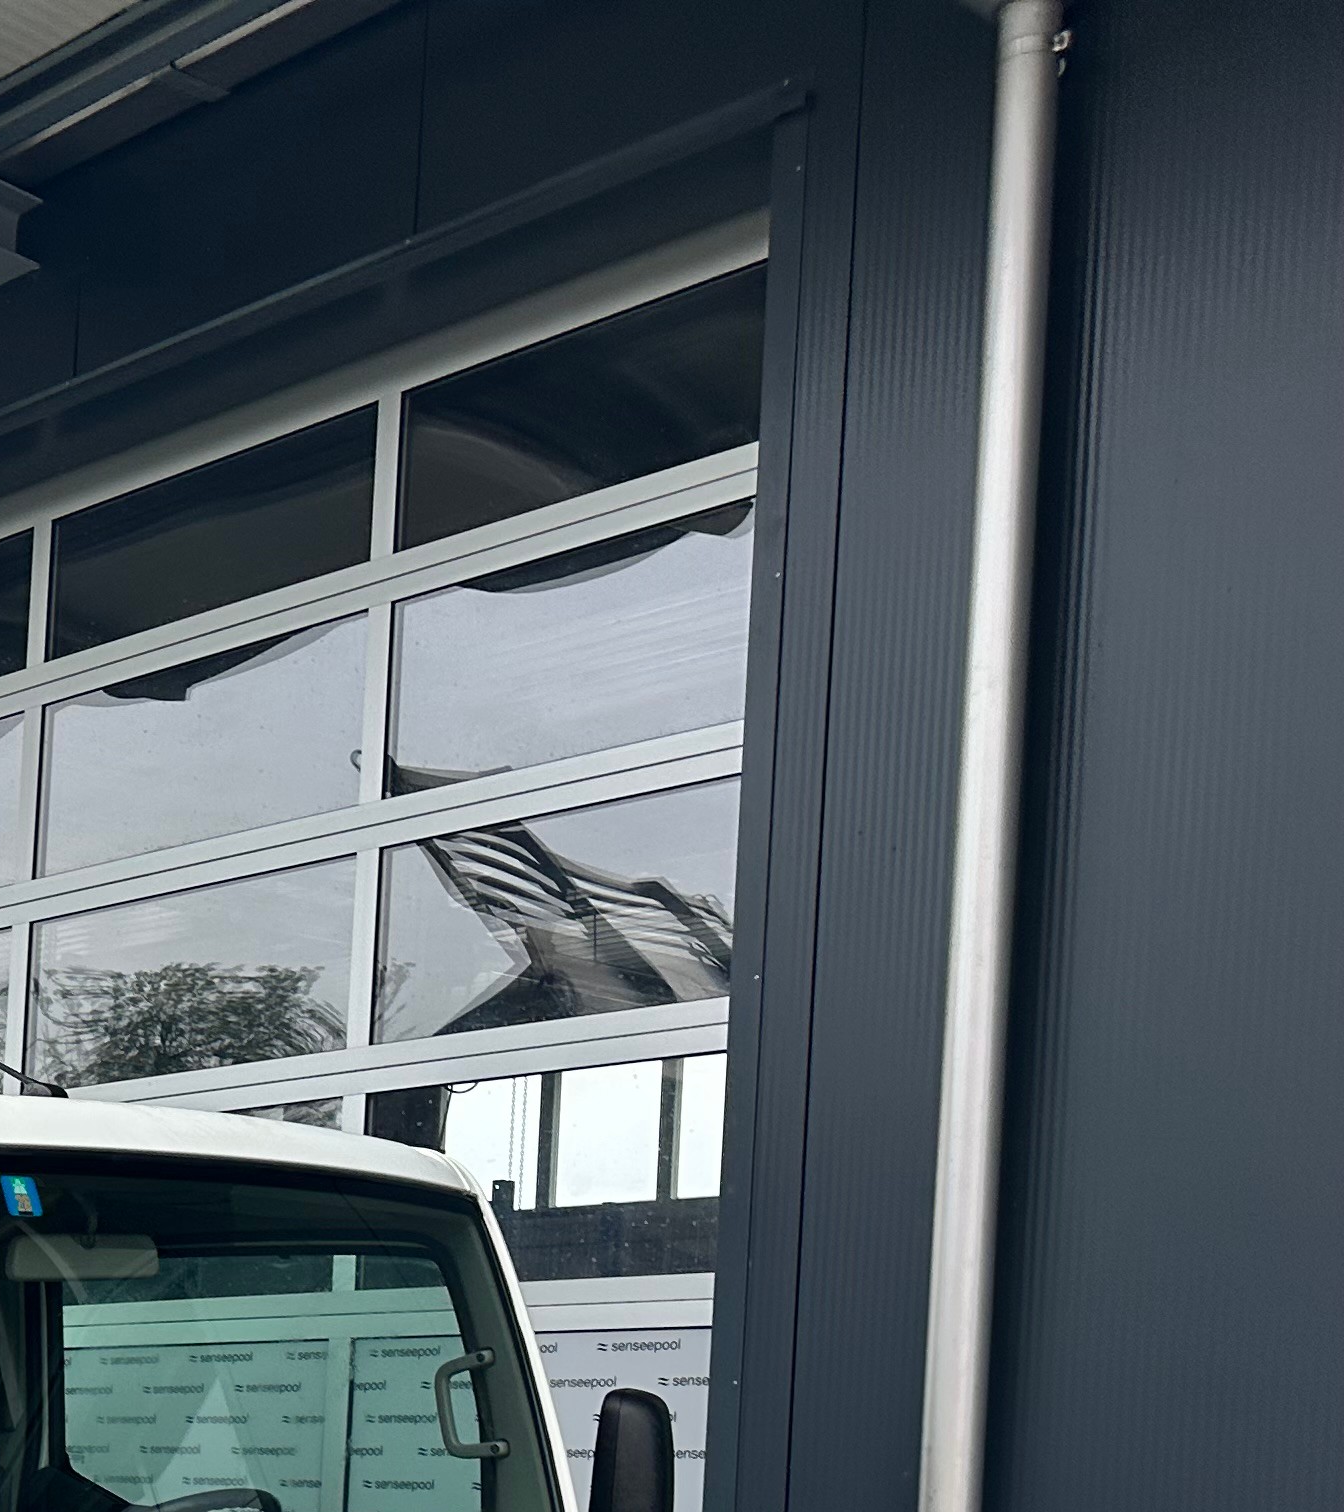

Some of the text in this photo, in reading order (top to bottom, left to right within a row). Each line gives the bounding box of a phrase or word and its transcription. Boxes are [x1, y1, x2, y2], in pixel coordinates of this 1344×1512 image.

[380, 1345, 441, 1361] senseepool
[611, 1338, 682, 1353] senseepool
[549, 1375, 618, 1390] senseepool
[377, 1411, 438, 1426] senseepool
[374, 1479, 435, 1493] senseepool
